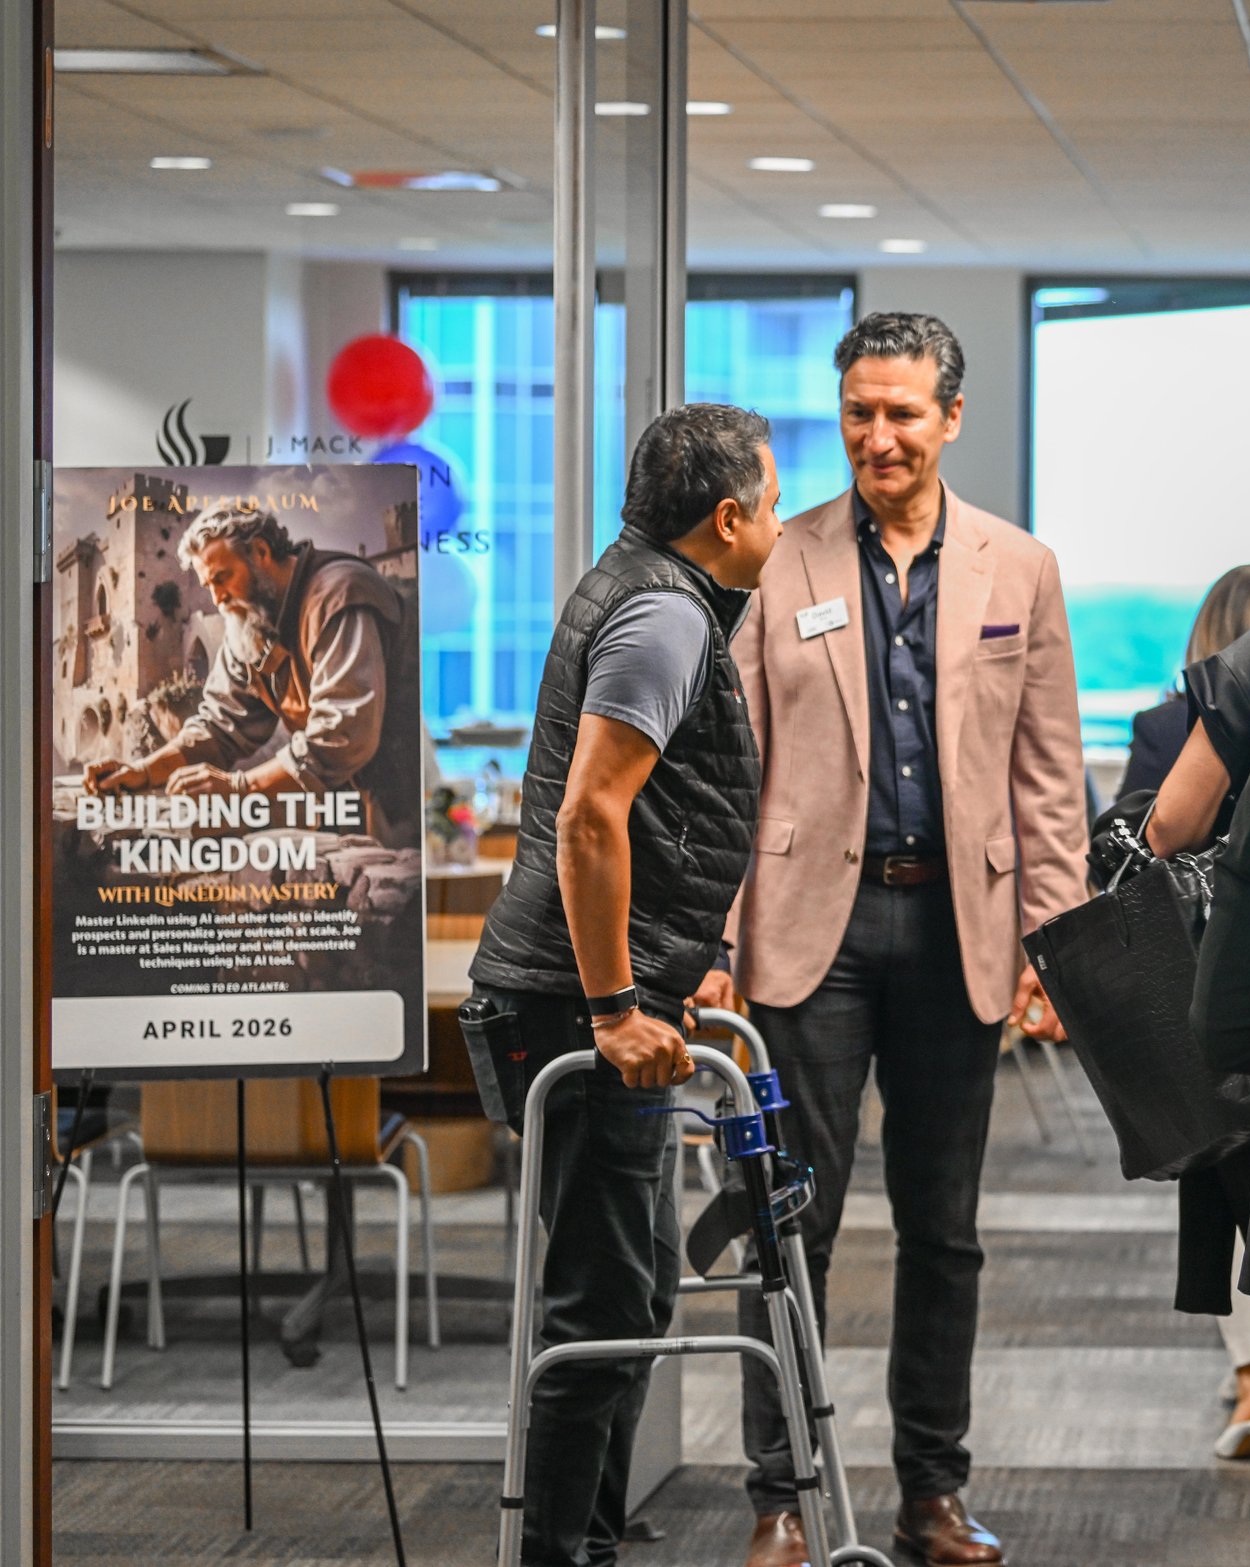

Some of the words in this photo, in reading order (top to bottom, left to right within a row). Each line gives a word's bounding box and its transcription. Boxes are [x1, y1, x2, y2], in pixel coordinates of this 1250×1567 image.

[266, 437, 282, 457] J.
[291, 435, 363, 454] MACK
[107, 495, 154, 515] JOE
[77, 793, 270, 830] BUILDING
[277, 791, 361, 827] THE
[120, 837, 317, 873] KINGDOM
[98, 886, 150, 904] WITH
[154, 885, 246, 907] LINKEDIN
[249, 882, 339, 904] MASTERY
[75, 915, 115, 927] Master
[116, 914, 164, 926] LinkedIn
[166, 913, 197, 927] using
[199, 913, 212, 925] AI
[214, 912, 236, 924] and
[237, 912, 268, 924] other
[270, 911, 298, 923] tools
[299, 912, 312, 923] to
[313, 910, 358, 924] identify
[72, 930, 126, 943] prospects
[128, 928, 150, 941] and
[152, 927, 215, 942] personalize
[217, 928, 243, 940] your
[245, 925, 294, 938] outreach
[296, 926, 308, 937] at
[309, 924, 340, 937] scale.
[342, 924, 361, 936] Joe
[77, 943, 87, 955] is
[89, 945, 96, 955] a
[98, 943, 137, 955] master
[138, 943, 151, 954] at
[153, 942, 181, 954] Sales
[183, 941, 238, 955] Navigator
[239, 940, 261, 952] and
[262, 939, 284, 952] will
[285, 939, 357, 951] demonstrate
[140, 956, 200, 970] techniques
[202, 955, 234, 969] using
[235, 954, 252, 966] his
[253, 954, 267, 966] AI
[268, 953, 295, 966] tool.
[170, 983, 211, 994] COMING
[212, 982, 226, 993] TO
[226, 982, 240, 993] EO
[241, 981, 289, 993] ATLANTA:
[143, 1020, 221, 1039] APRIL
[232, 1018, 293, 1038] 2026
